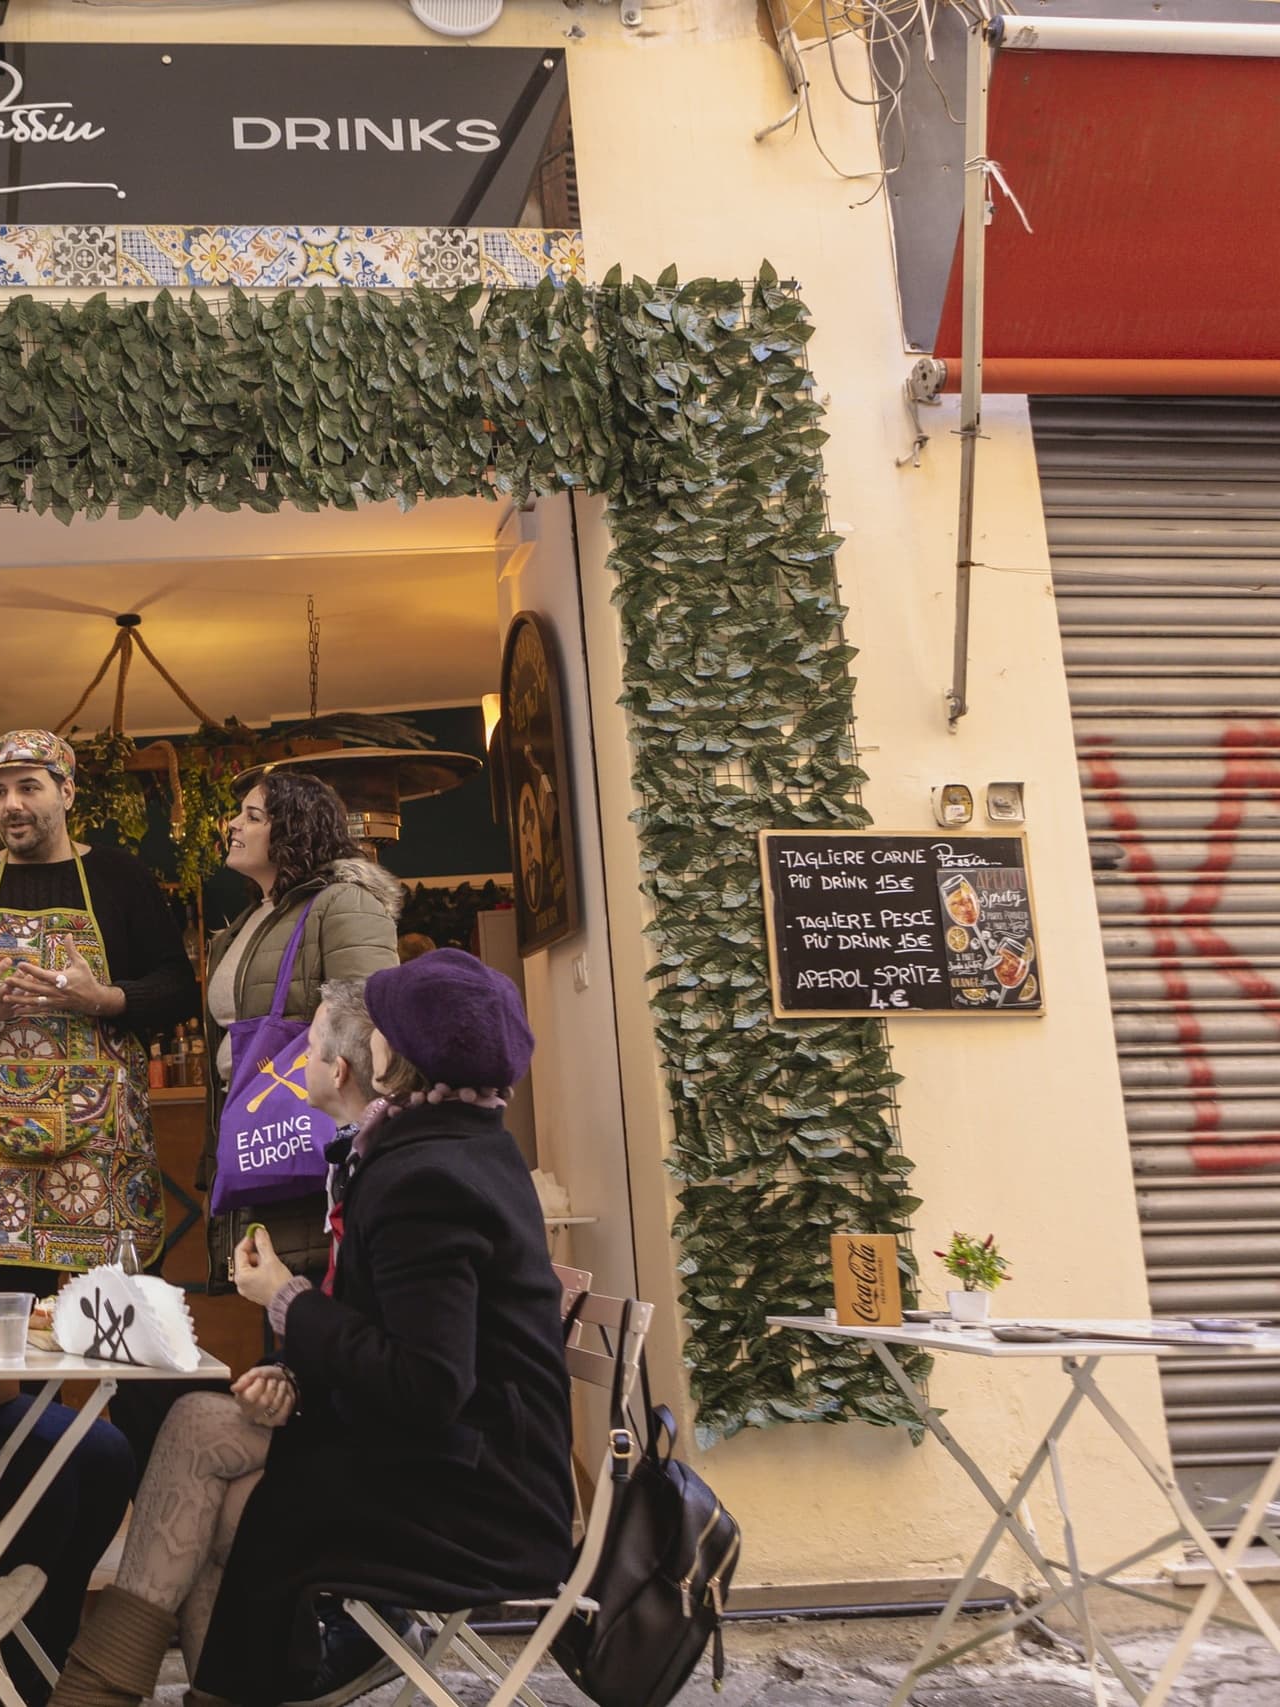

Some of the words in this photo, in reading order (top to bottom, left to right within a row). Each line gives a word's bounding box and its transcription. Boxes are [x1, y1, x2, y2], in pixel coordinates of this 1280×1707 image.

[232, 116, 502, 153] DRINKS
[871, 849, 927, 865] CARNE
[821, 871, 869, 891] DRINK
[875, 874, 915, 892] 15€
[795, 911, 876, 930] TAGLIERE
[879, 909, 936, 928] PESCE
[837, 930, 893, 951] DRINK
[896, 932, 933, 952] 15€
[796, 969, 870, 990] APEROL
[872, 962, 943, 987] SPRITZ
[236, 1115, 312, 1150] EATING
[238, 1134, 313, 1172] EUROPE
